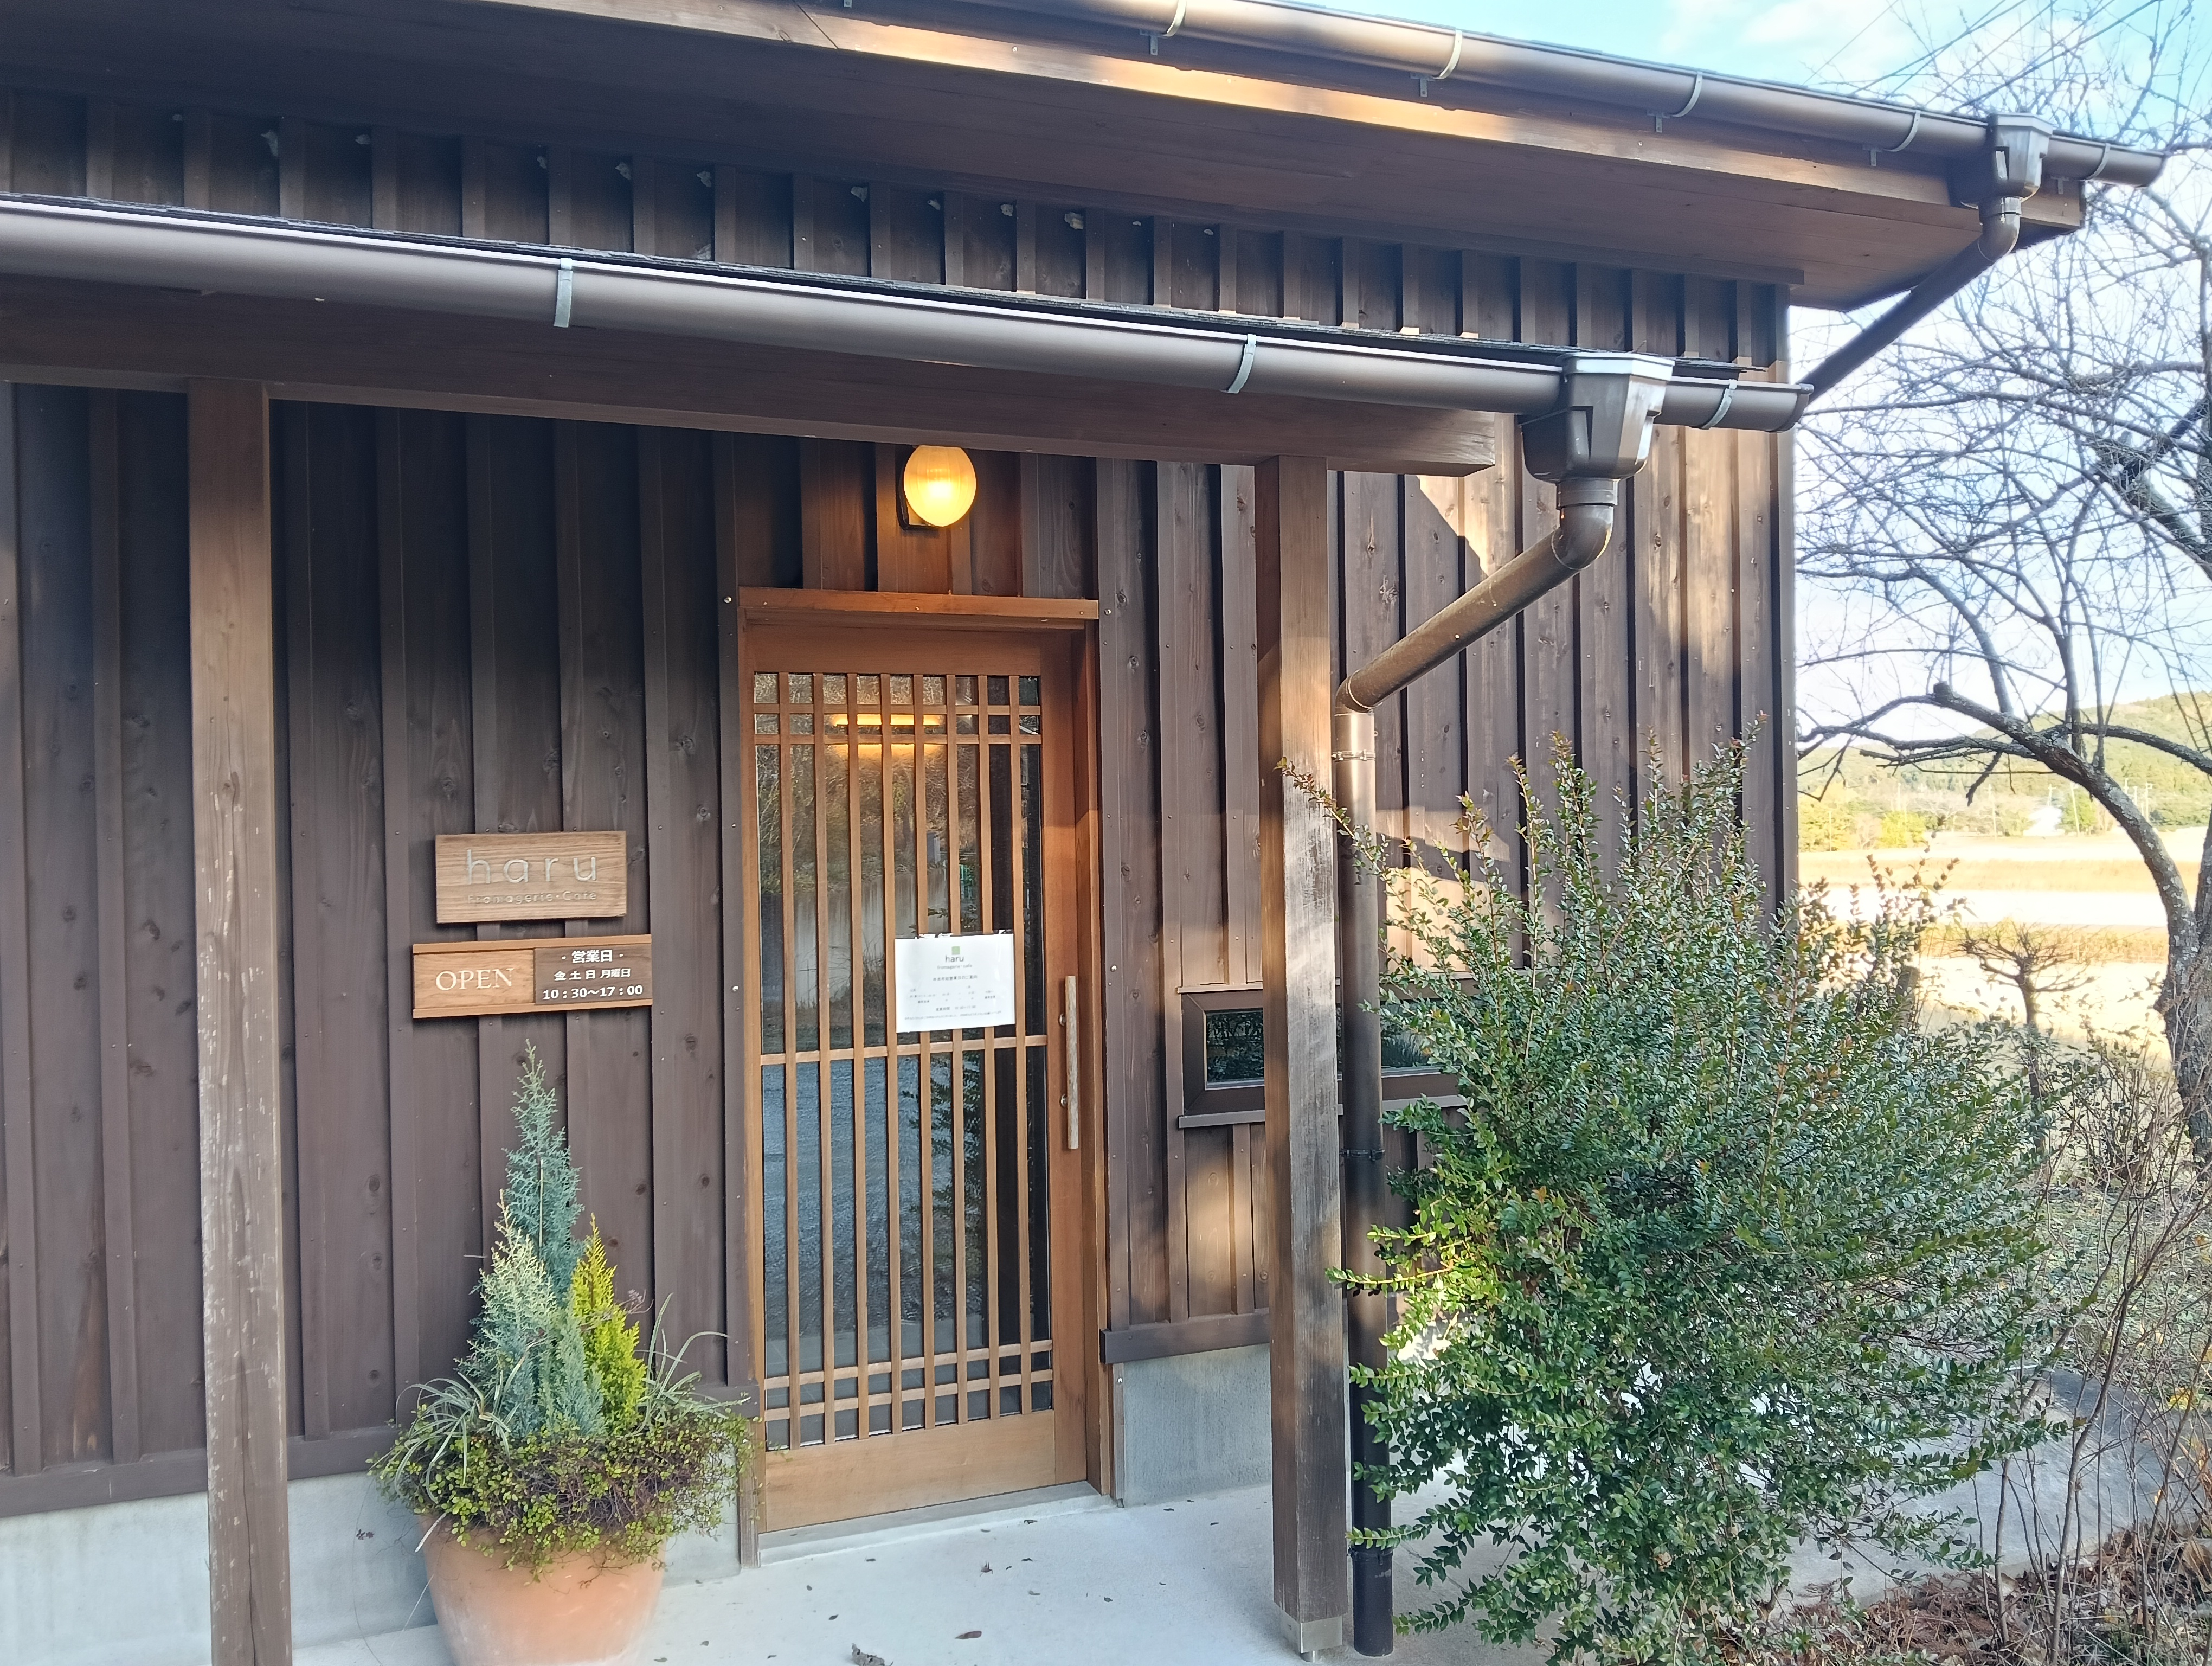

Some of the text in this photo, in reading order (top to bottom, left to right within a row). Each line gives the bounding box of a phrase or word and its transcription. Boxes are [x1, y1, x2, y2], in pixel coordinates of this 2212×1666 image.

[466, 849, 596, 885] haru
[945, 954, 964, 963] haru
[435, 968, 515, 991] OPEN
